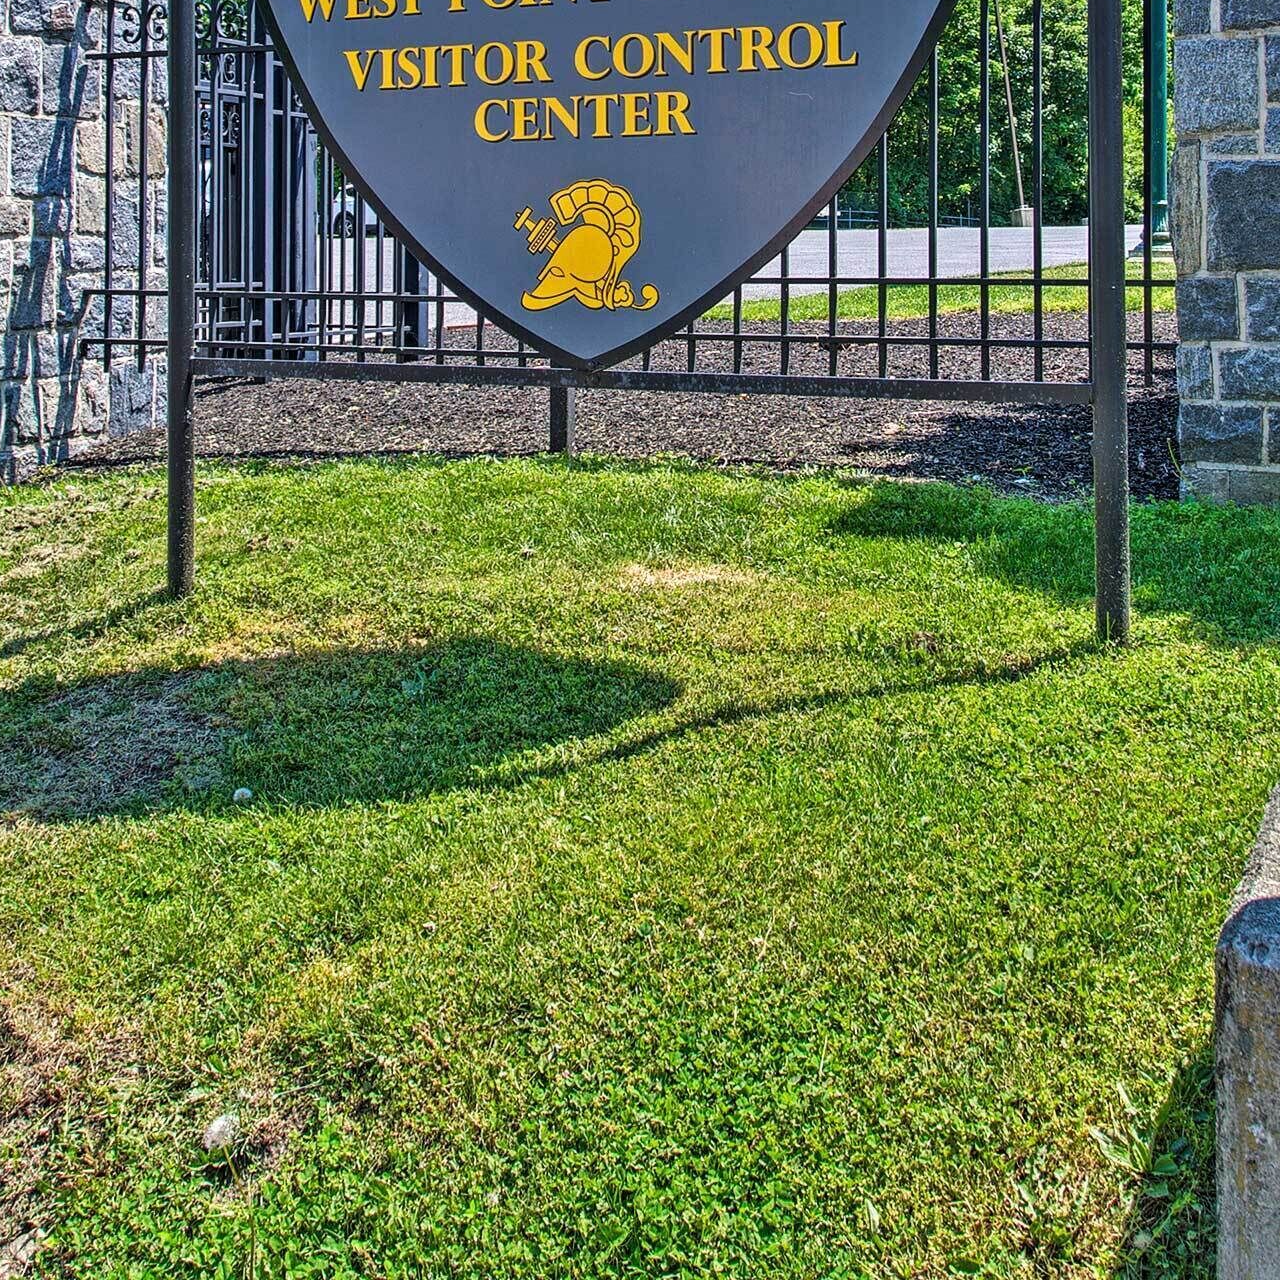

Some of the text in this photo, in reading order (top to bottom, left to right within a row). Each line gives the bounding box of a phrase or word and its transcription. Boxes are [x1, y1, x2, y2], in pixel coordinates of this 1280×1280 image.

[344, 20, 858, 90] VISITOR CONTROL
[473, 91, 696, 142] CENTER
